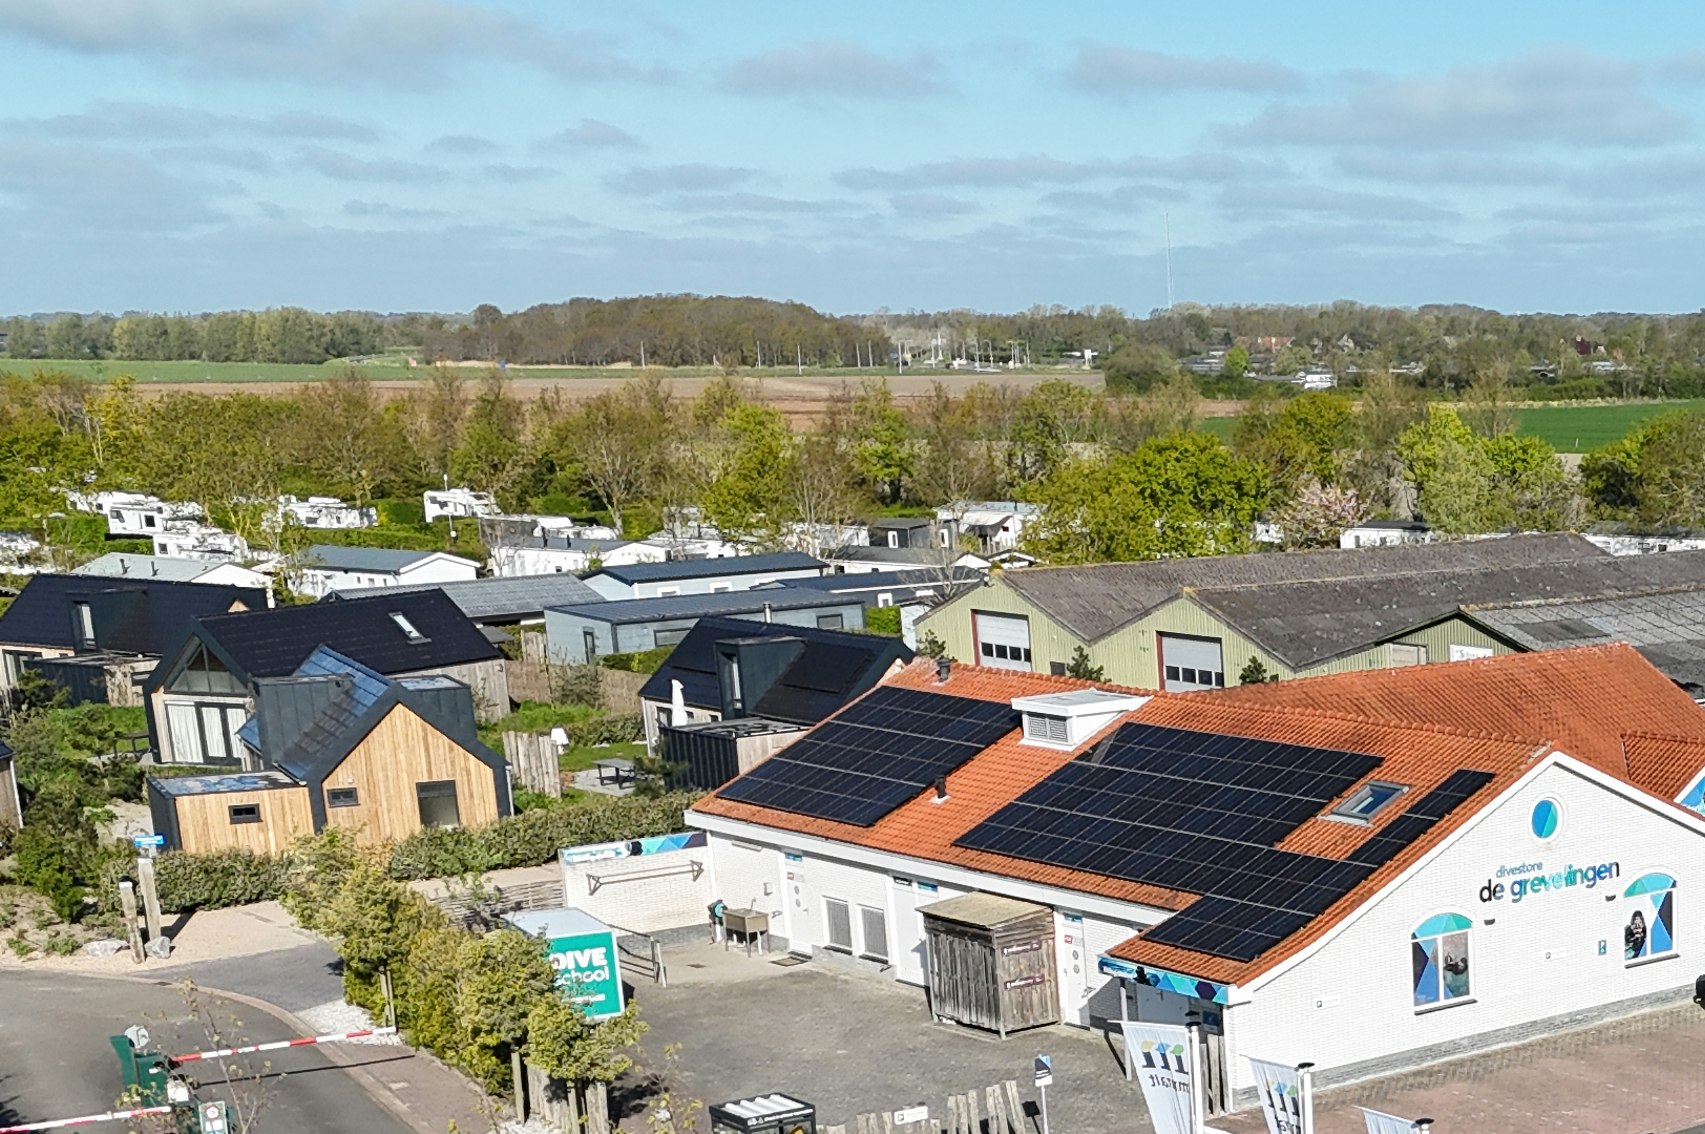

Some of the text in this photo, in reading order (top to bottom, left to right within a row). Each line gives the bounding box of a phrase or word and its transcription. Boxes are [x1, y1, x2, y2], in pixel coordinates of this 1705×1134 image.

[1480, 861, 1620, 903] de grevelingen
[550, 947, 607, 969] DIVE
